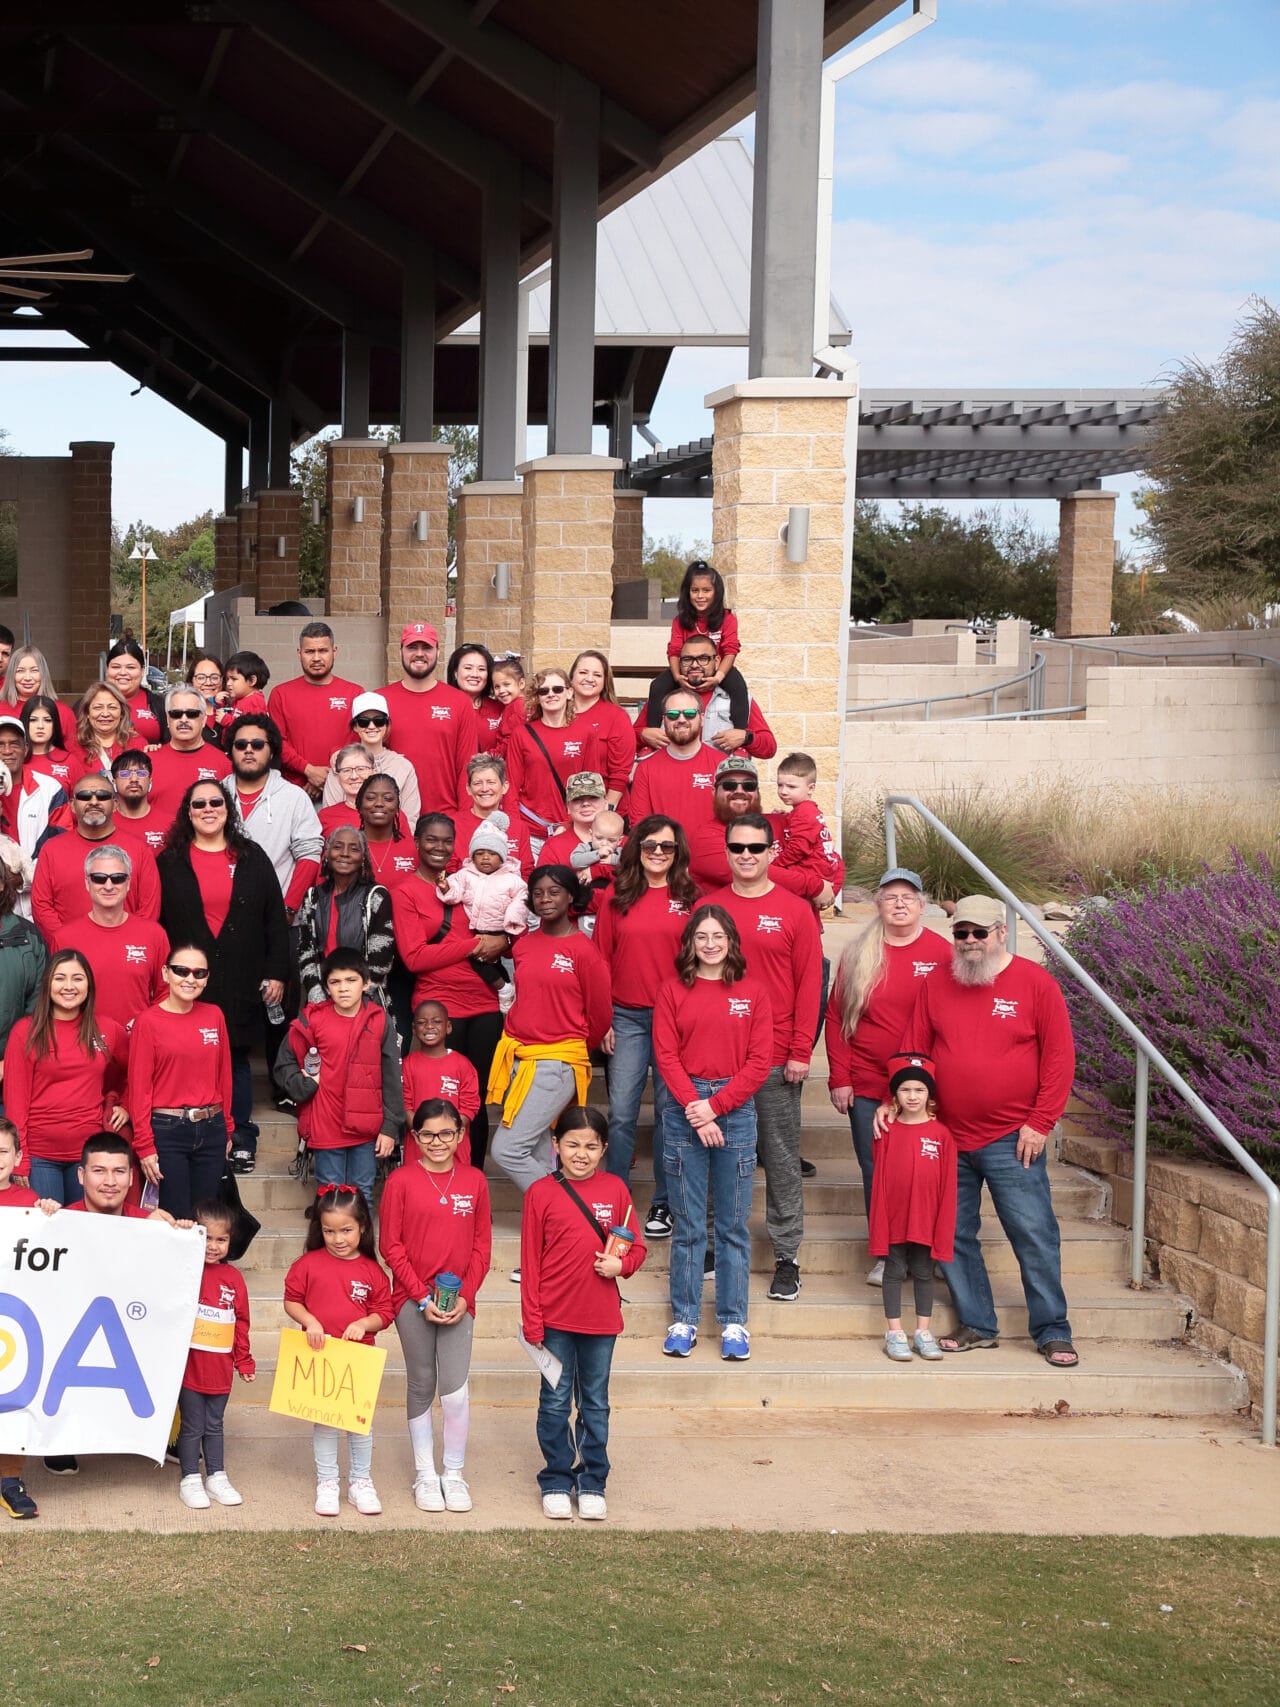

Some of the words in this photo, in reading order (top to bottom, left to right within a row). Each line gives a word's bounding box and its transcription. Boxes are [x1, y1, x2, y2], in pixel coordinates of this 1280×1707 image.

[13, 1237, 68, 1272] for
[196, 1307, 220, 1320] MDA
[292, 1355, 356, 1405] MDA
